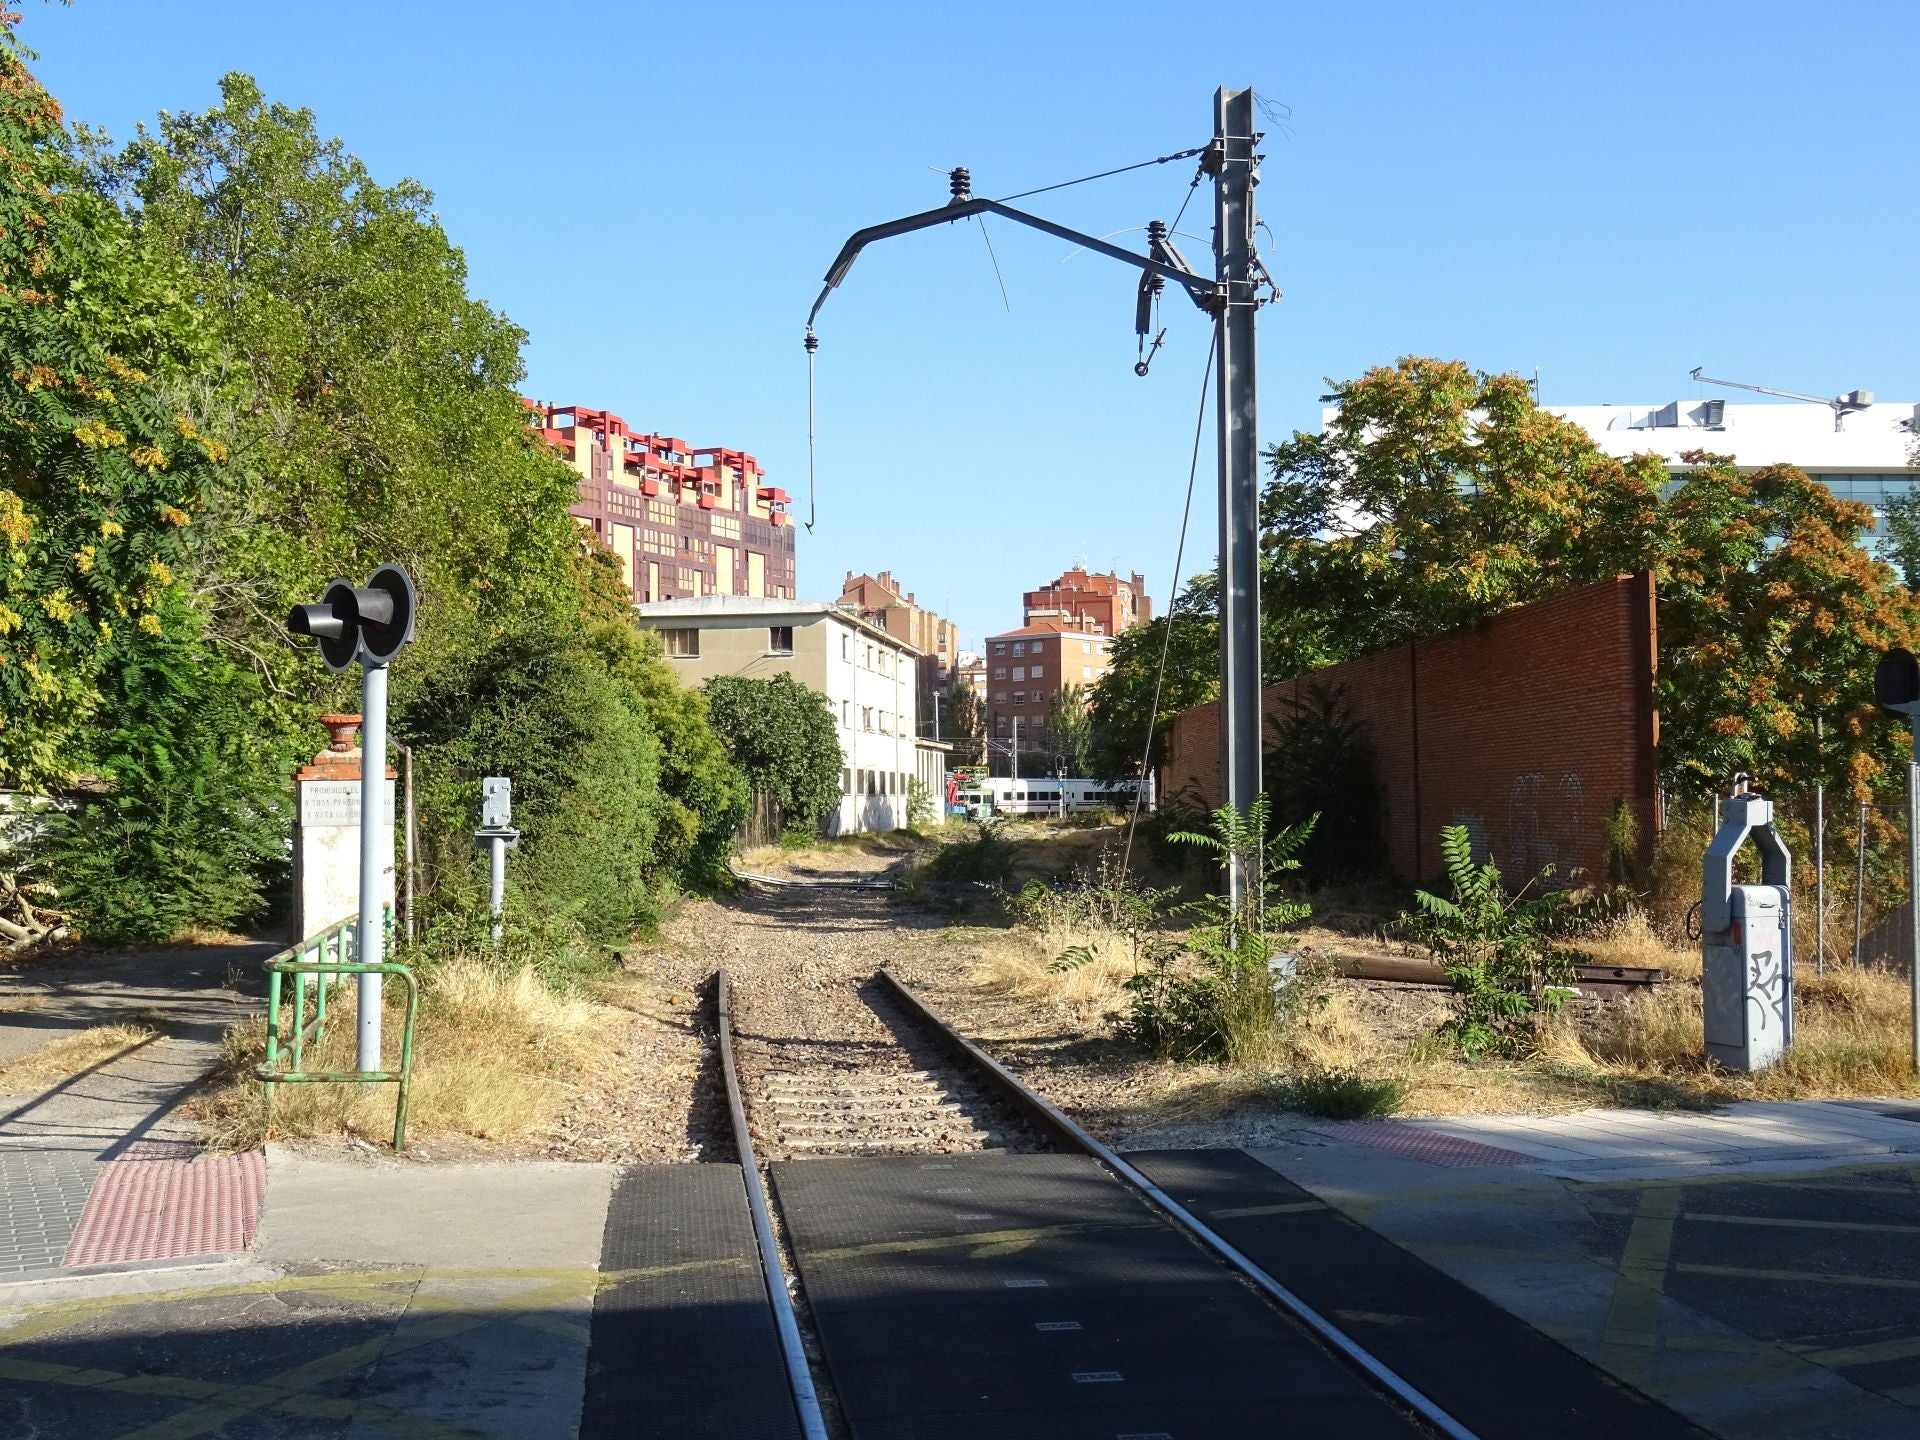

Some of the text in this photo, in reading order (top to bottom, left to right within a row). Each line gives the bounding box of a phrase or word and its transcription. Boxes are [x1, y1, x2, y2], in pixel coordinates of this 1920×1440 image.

[310, 786, 359, 794] PROHIBIDO EL
[333, 798, 361, 806] PERSON
